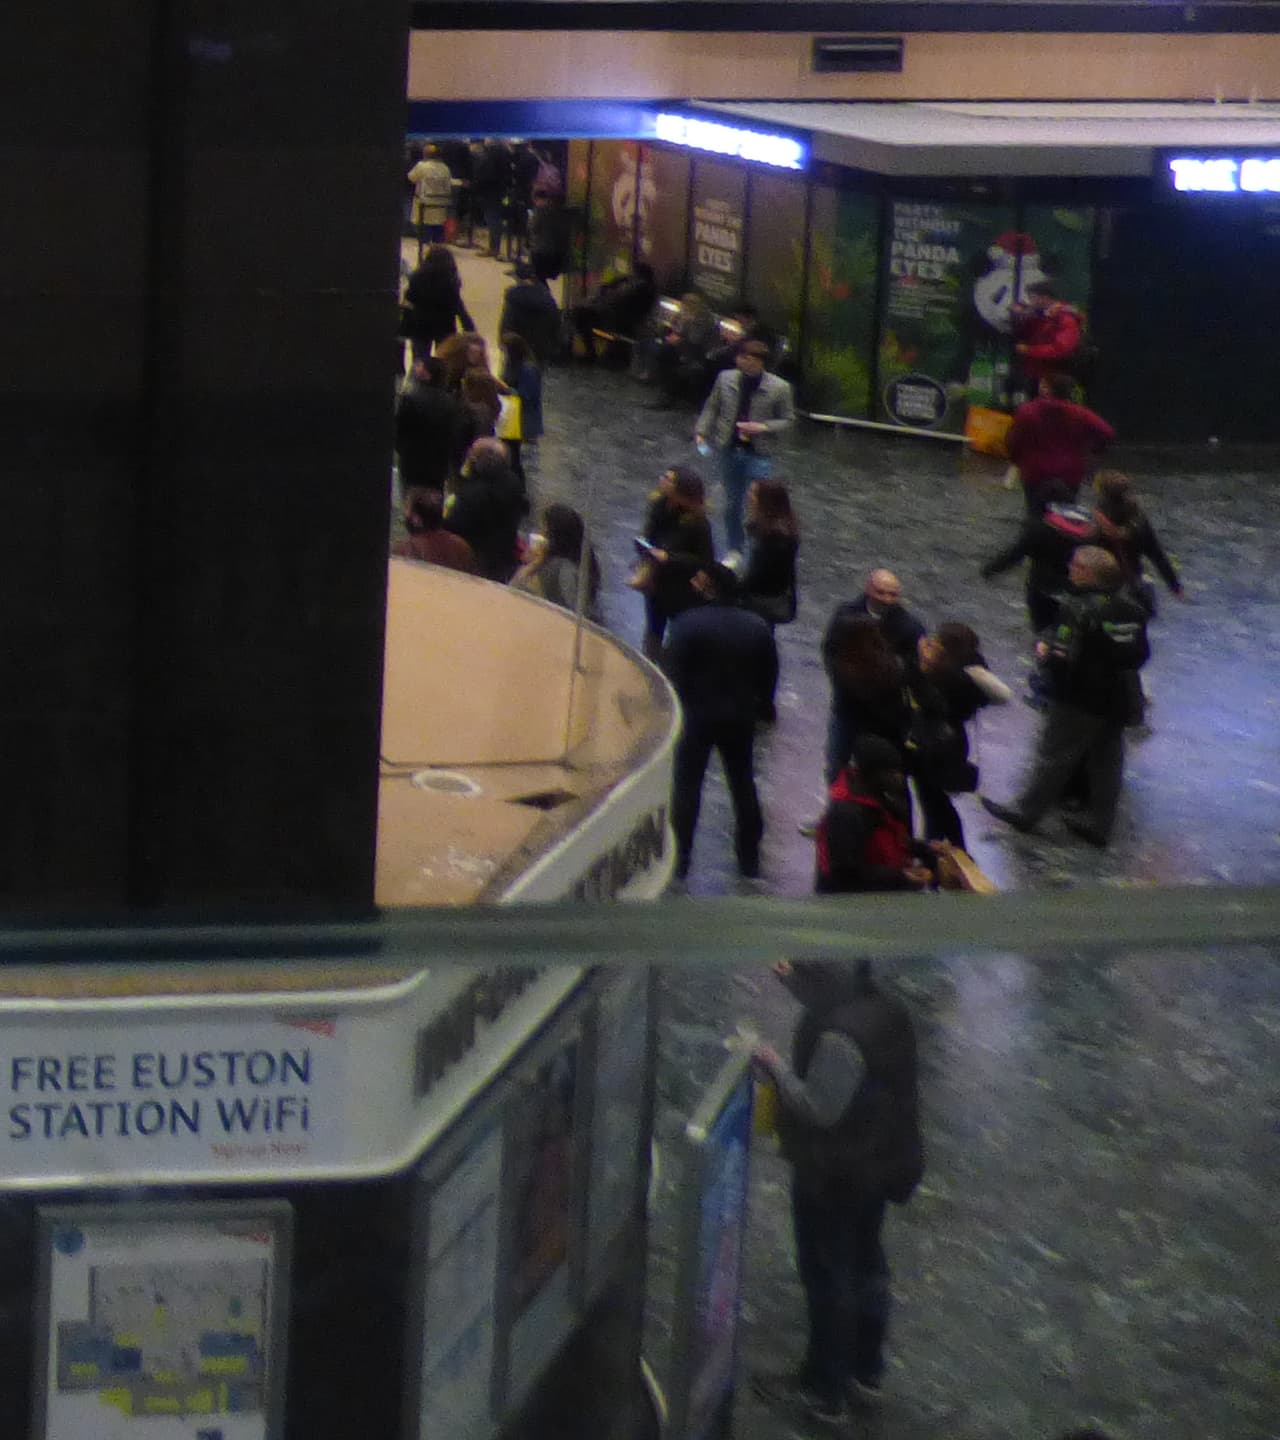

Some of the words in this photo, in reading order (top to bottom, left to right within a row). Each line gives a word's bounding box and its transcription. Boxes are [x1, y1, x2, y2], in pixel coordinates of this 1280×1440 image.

[891, 241, 960, 263] PANDA
[11, 1055, 116, 1092] FREE
[131, 1047, 311, 1089] EUSTON
[8, 1100, 201, 1140] STATION
[217, 1095, 310, 1134] WiFi
